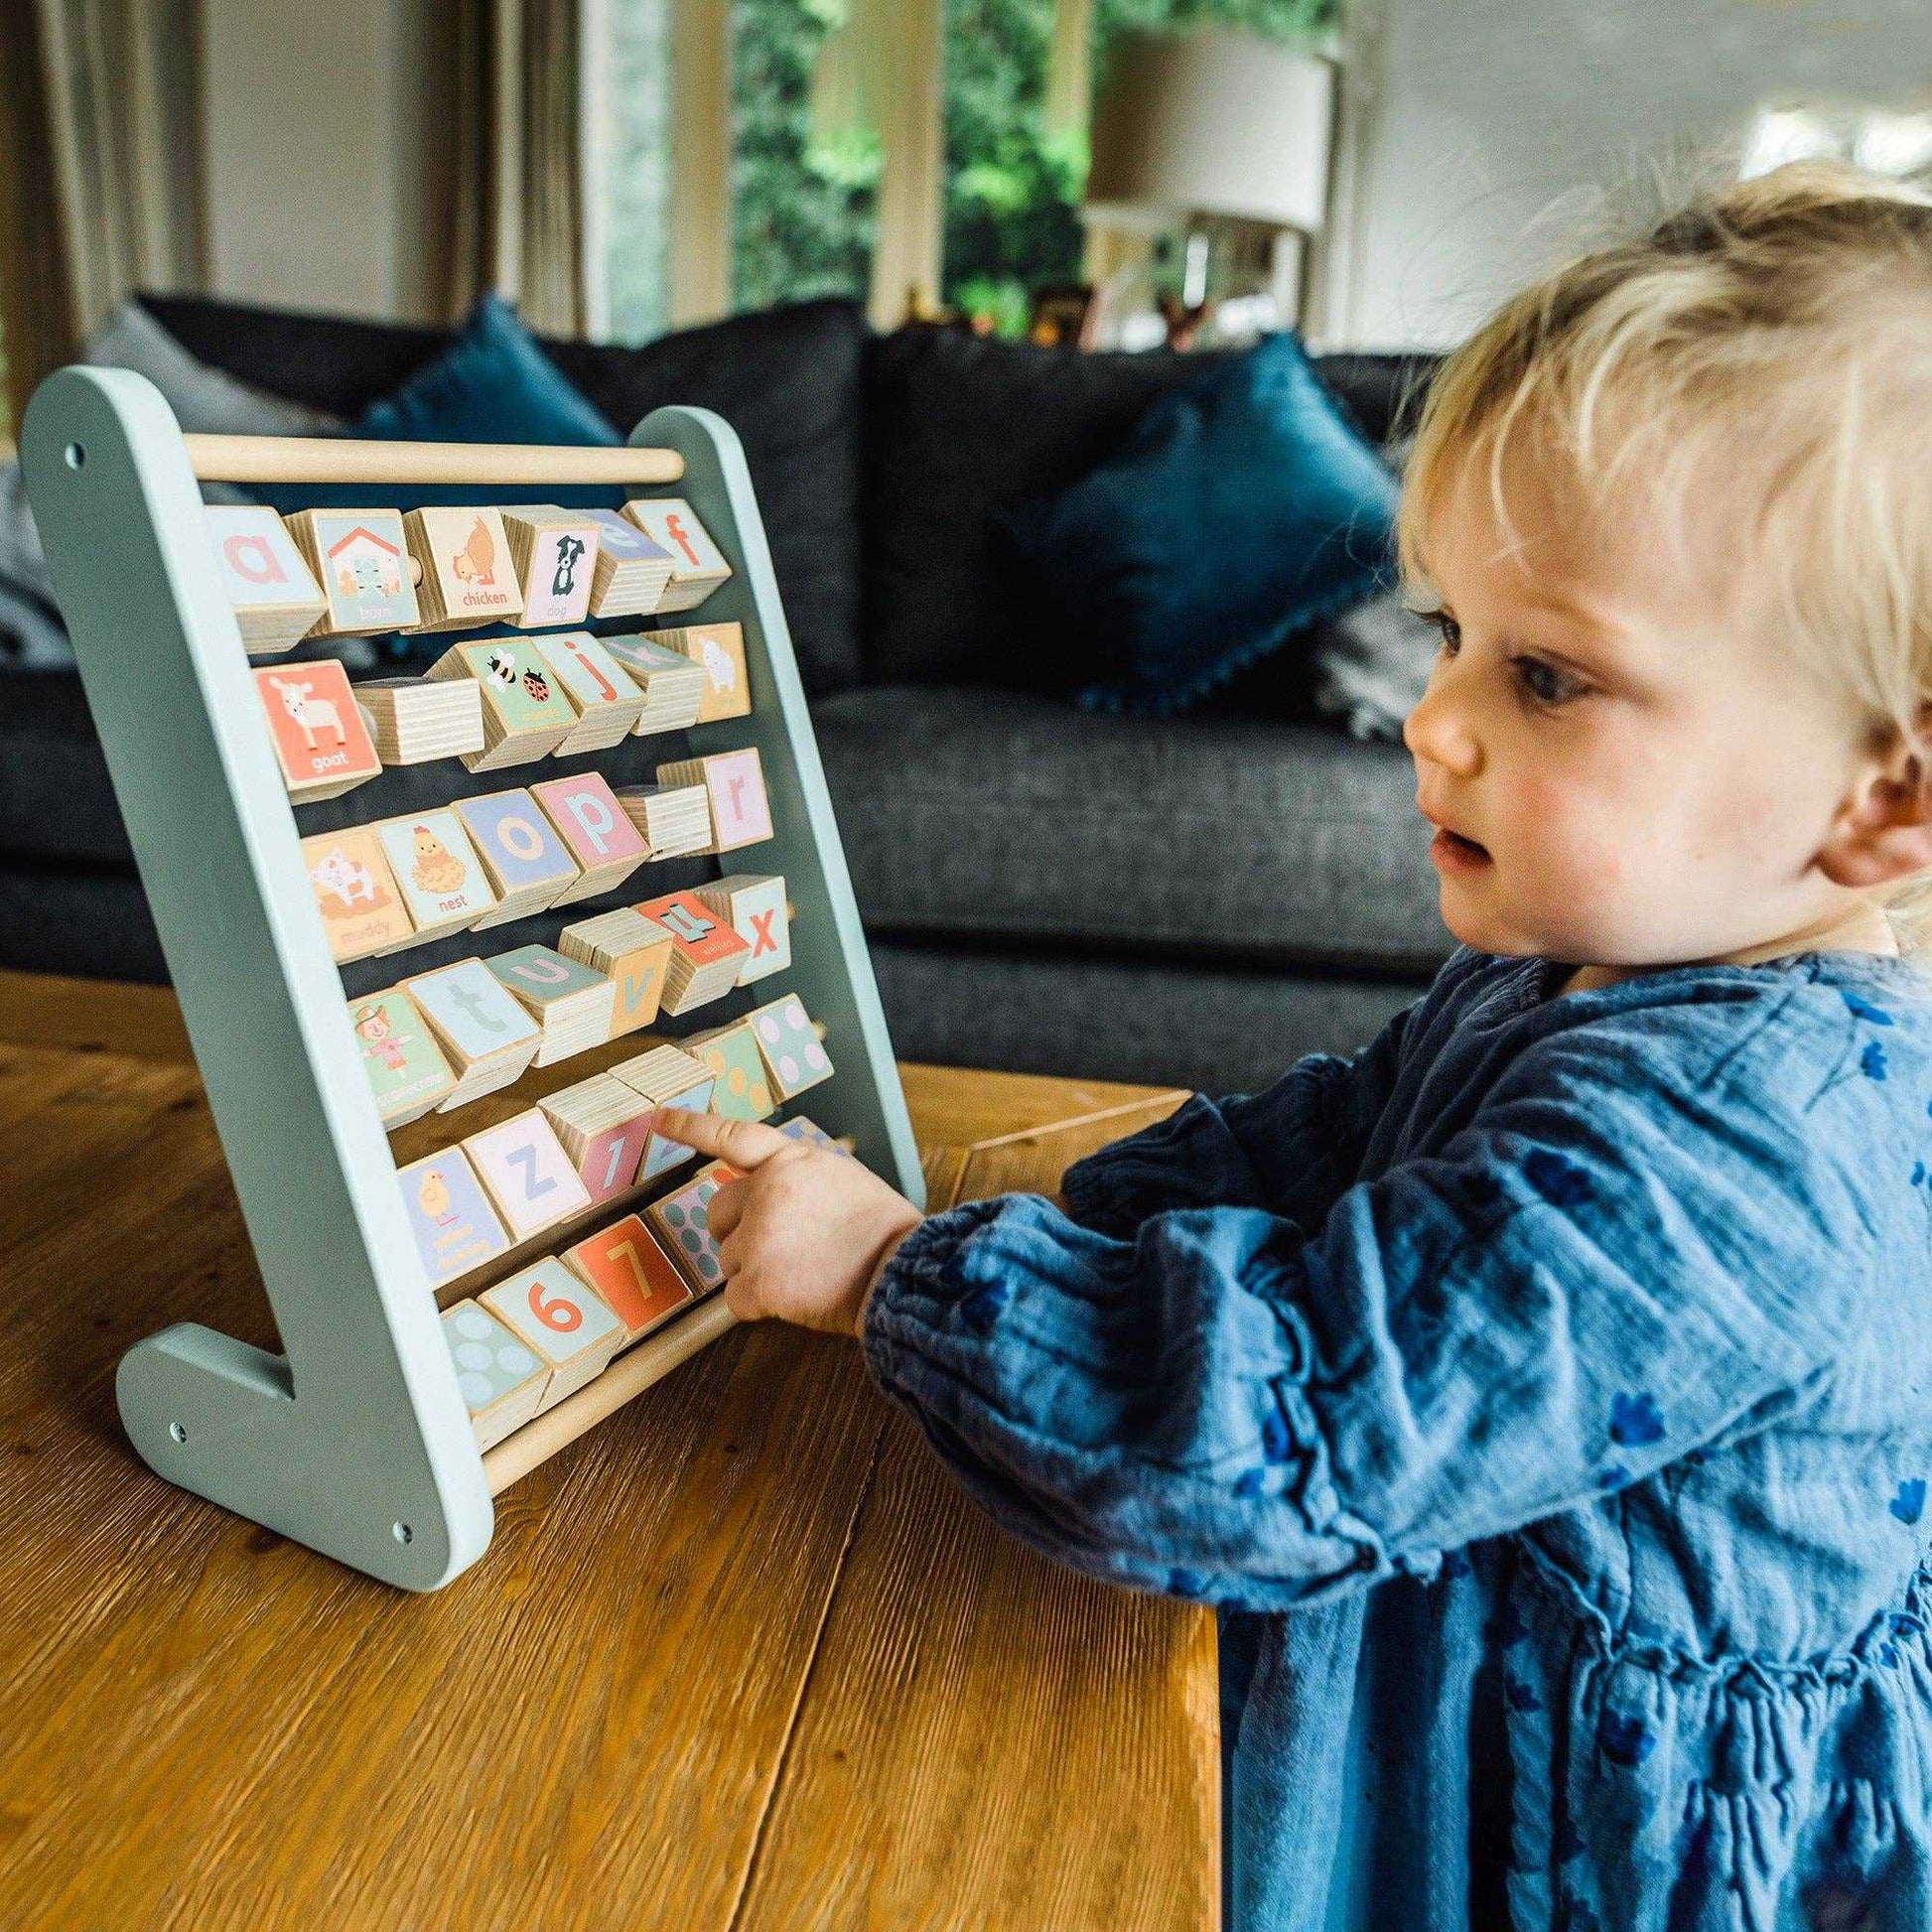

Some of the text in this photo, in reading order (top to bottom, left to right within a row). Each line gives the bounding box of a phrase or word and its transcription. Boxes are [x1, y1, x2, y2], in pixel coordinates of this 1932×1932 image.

[223, 535, 289, 584] a
[665, 514, 700, 566] f
[463, 591, 508, 608] chicken
[547, 604, 568, 621] dog
[564, 640, 618, 703] j
[311, 753, 350, 773] goat
[728, 773, 745, 821] r
[497, 817, 544, 861] o
[563, 791, 615, 856] p
[438, 896, 469, 913] nest
[340, 920, 390, 944] muddy
[750, 908, 778, 958] x
[510, 958, 572, 984] u
[624, 967, 654, 1014] v
[447, 983, 509, 1033] t
[604, 1136, 626, 1189] 1
[606, 1239, 652, 1300] 7
[528, 1282, 583, 1333] 6
